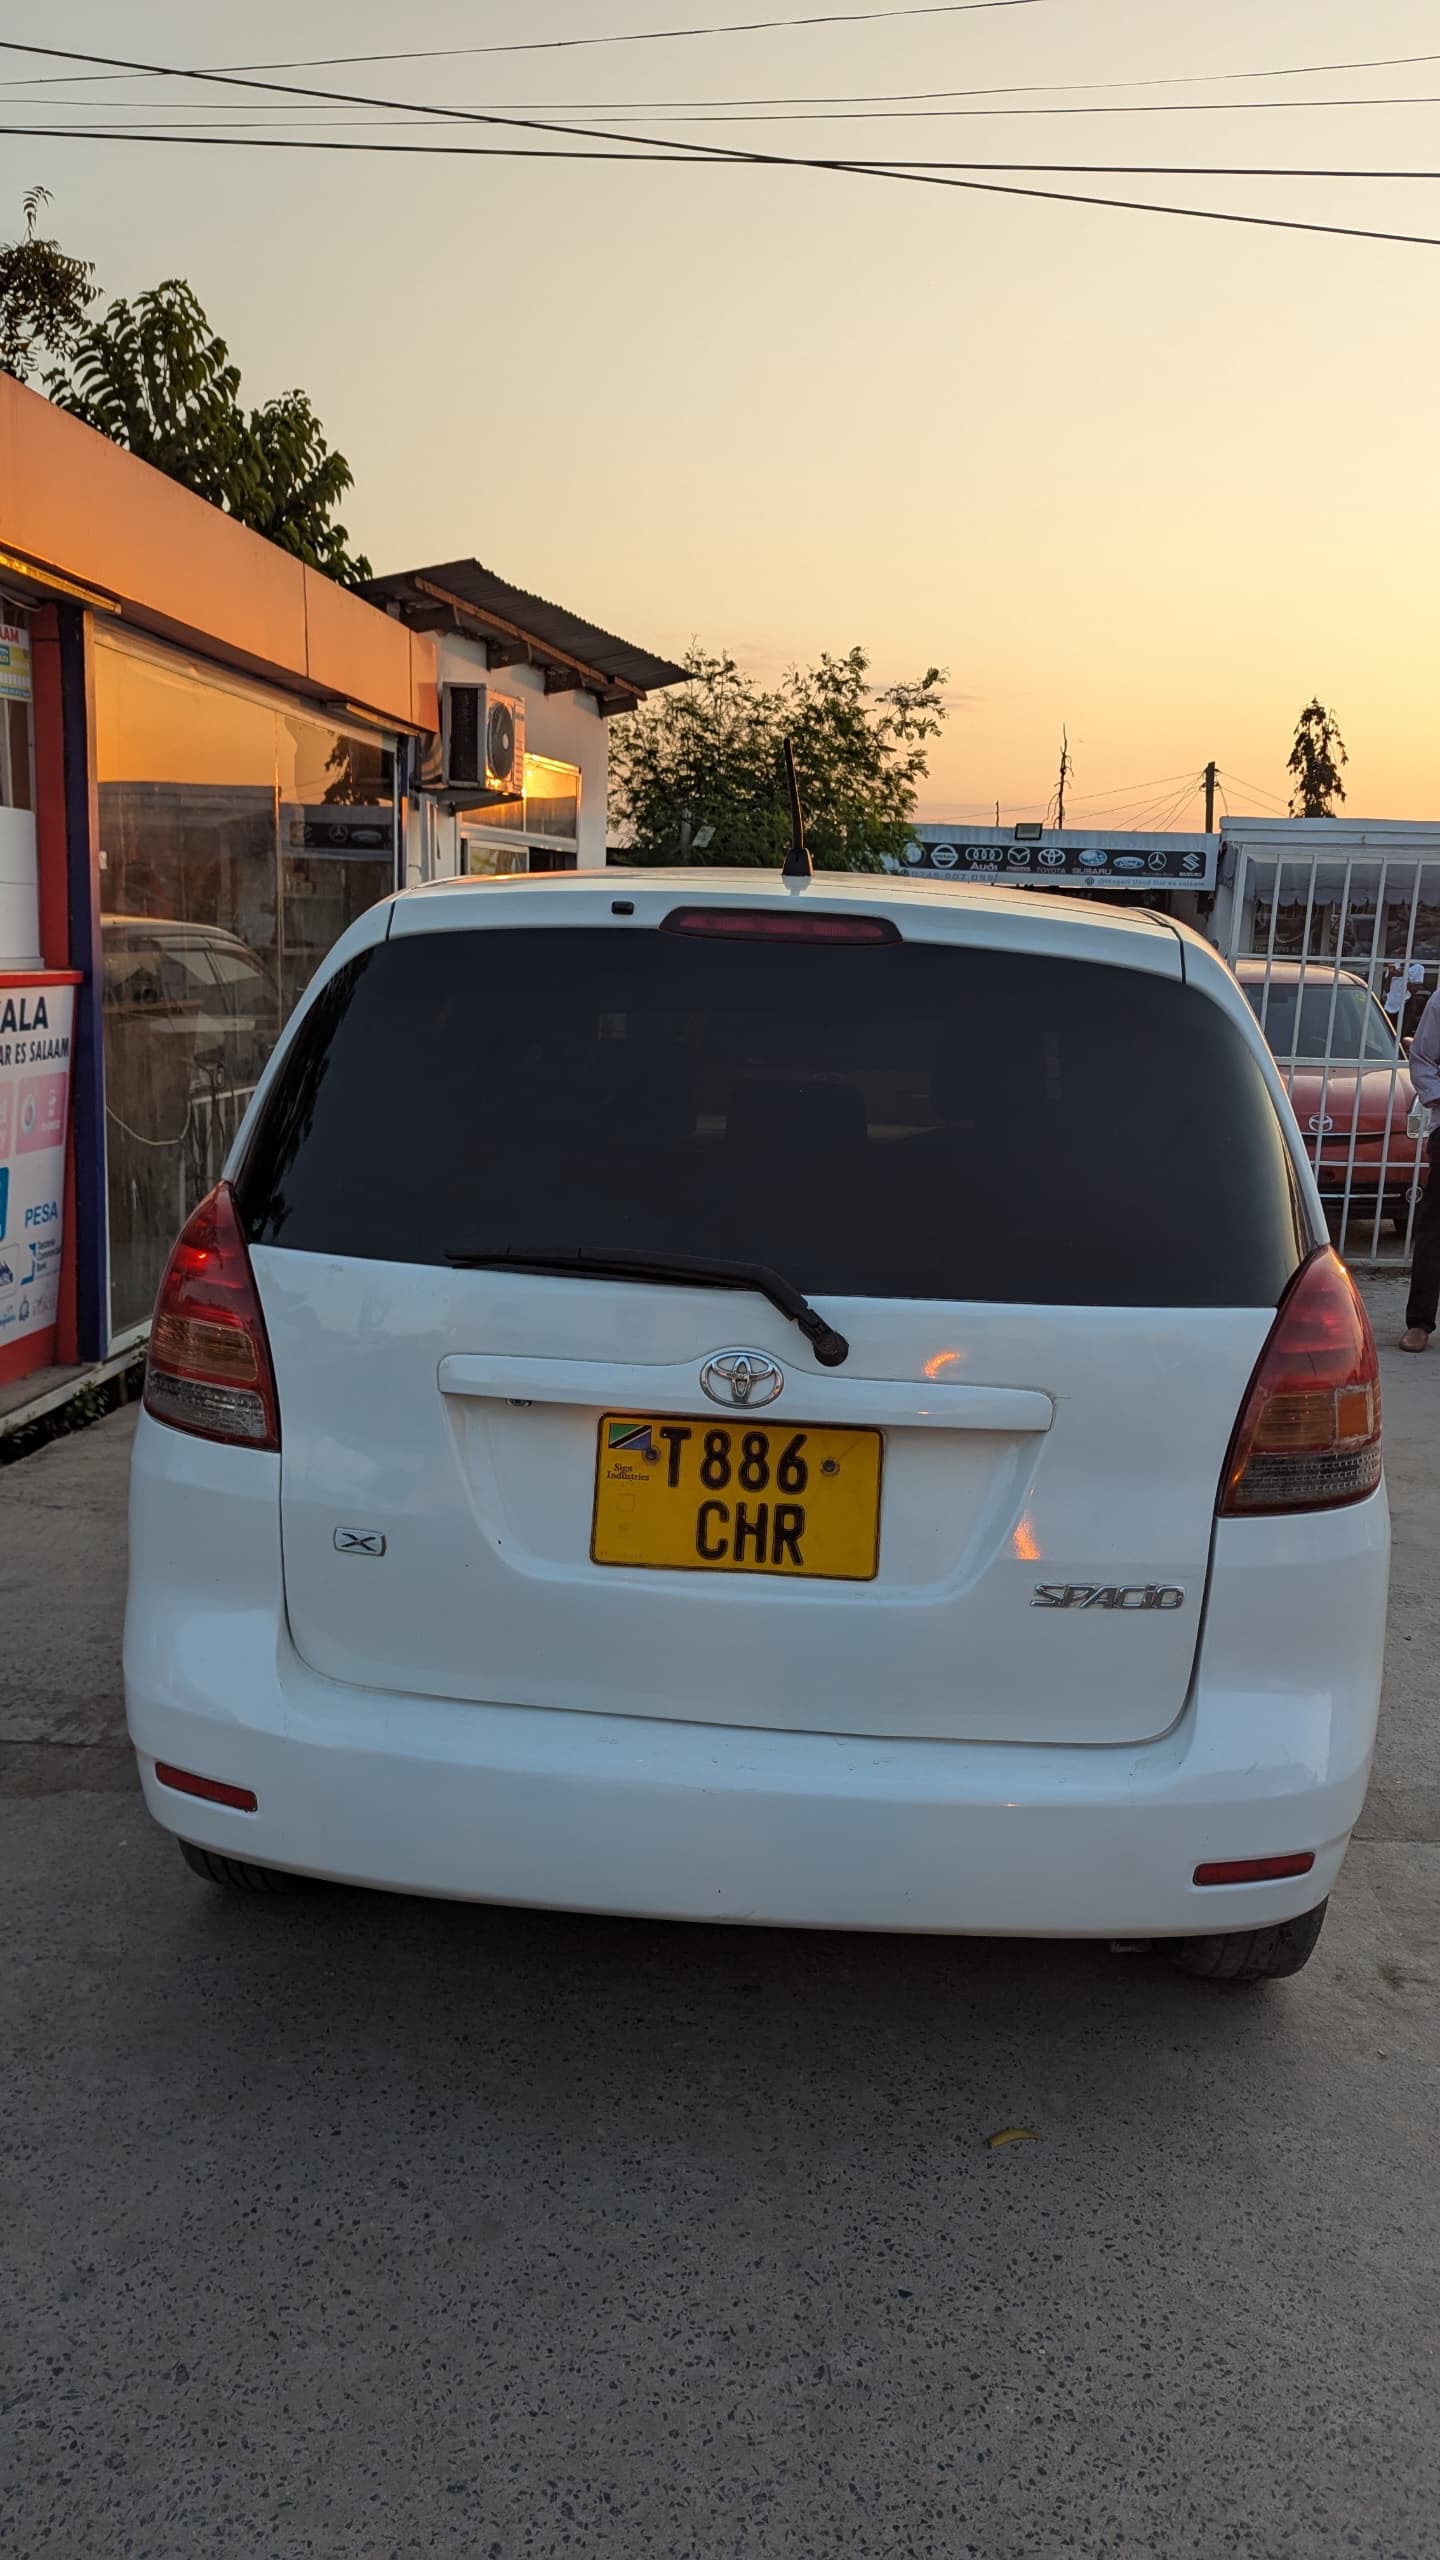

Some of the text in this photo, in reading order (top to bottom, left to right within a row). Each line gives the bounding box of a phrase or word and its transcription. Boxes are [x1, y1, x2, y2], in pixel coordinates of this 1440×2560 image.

[970, 862, 998, 871] Audi
[15, 1042, 26, 1064] ES
[29, 1037, 69, 1062] SALAAM
[25, 1201, 58, 1229] PESA
[607, 1470, 650, 1481] Industries
[613, 1463, 633, 1474] Sign
[341, 1532, 377, 1552] X
[696, 1499, 805, 1566] CHR
